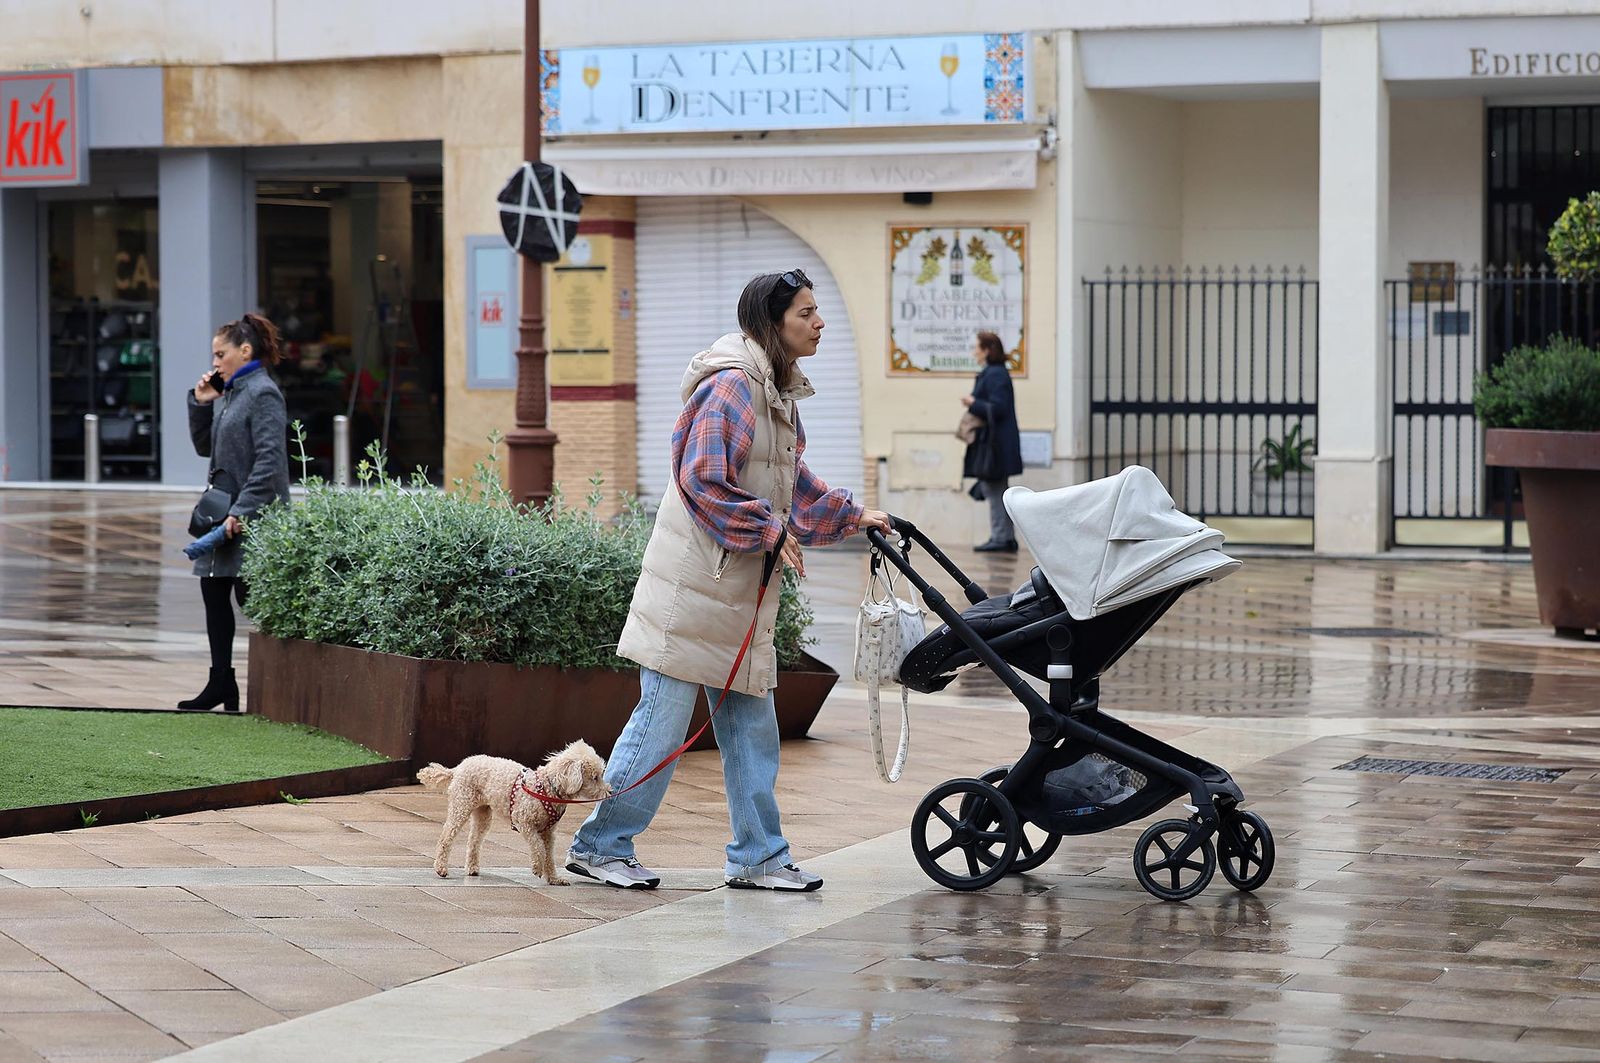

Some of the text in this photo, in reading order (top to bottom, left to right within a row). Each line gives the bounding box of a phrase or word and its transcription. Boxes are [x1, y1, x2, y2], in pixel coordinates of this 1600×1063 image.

[631, 44, 906, 79] LA TABERNA
[631, 83, 911, 123] DENFRENTE
[6, 82, 67, 168] kik
[710, 166, 844, 187] DENFRENTE
[869, 167, 937, 185] VINOS
[115, 251, 159, 291] CA
[901, 301, 1016, 320] DENFRENTE
[929, 287, 1008, 301] TABERNA
